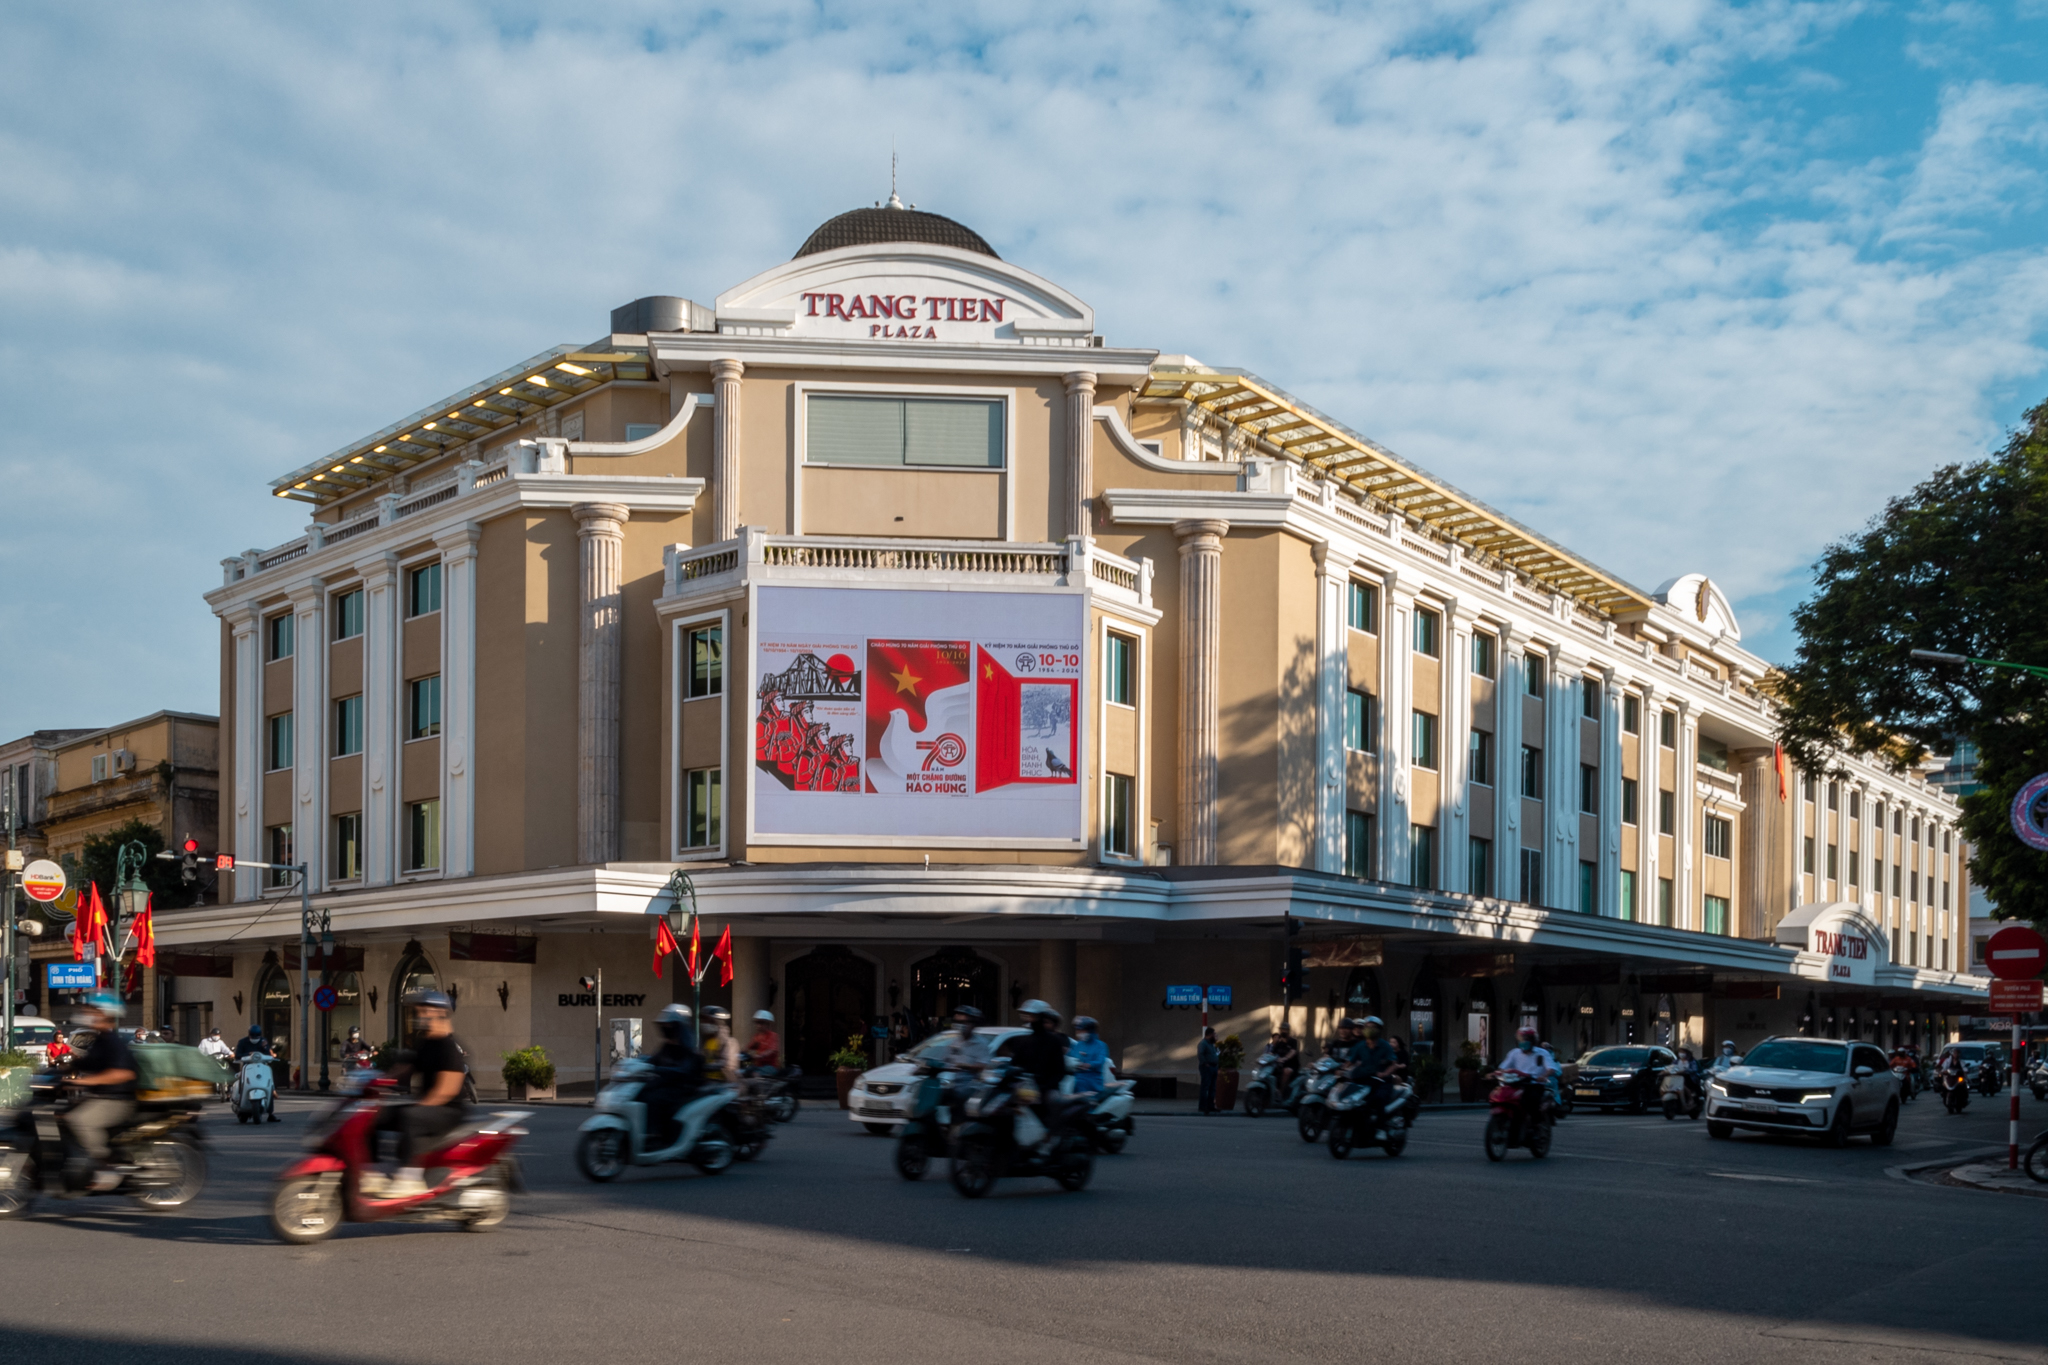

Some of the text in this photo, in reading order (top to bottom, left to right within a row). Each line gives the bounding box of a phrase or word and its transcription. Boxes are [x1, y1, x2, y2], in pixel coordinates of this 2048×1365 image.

[802, 292, 1006, 322] TRANG TIEN
[872, 324, 937, 339] PLAZA
[937, 650, 967, 660] 10/10
[907, 772, 920, 782] MỘT
[1815, 929, 1868, 960] TRANG TIEN
[1833, 964, 1851, 978] PLAZA
[1413, 998, 1432, 1006] HUBLOT
